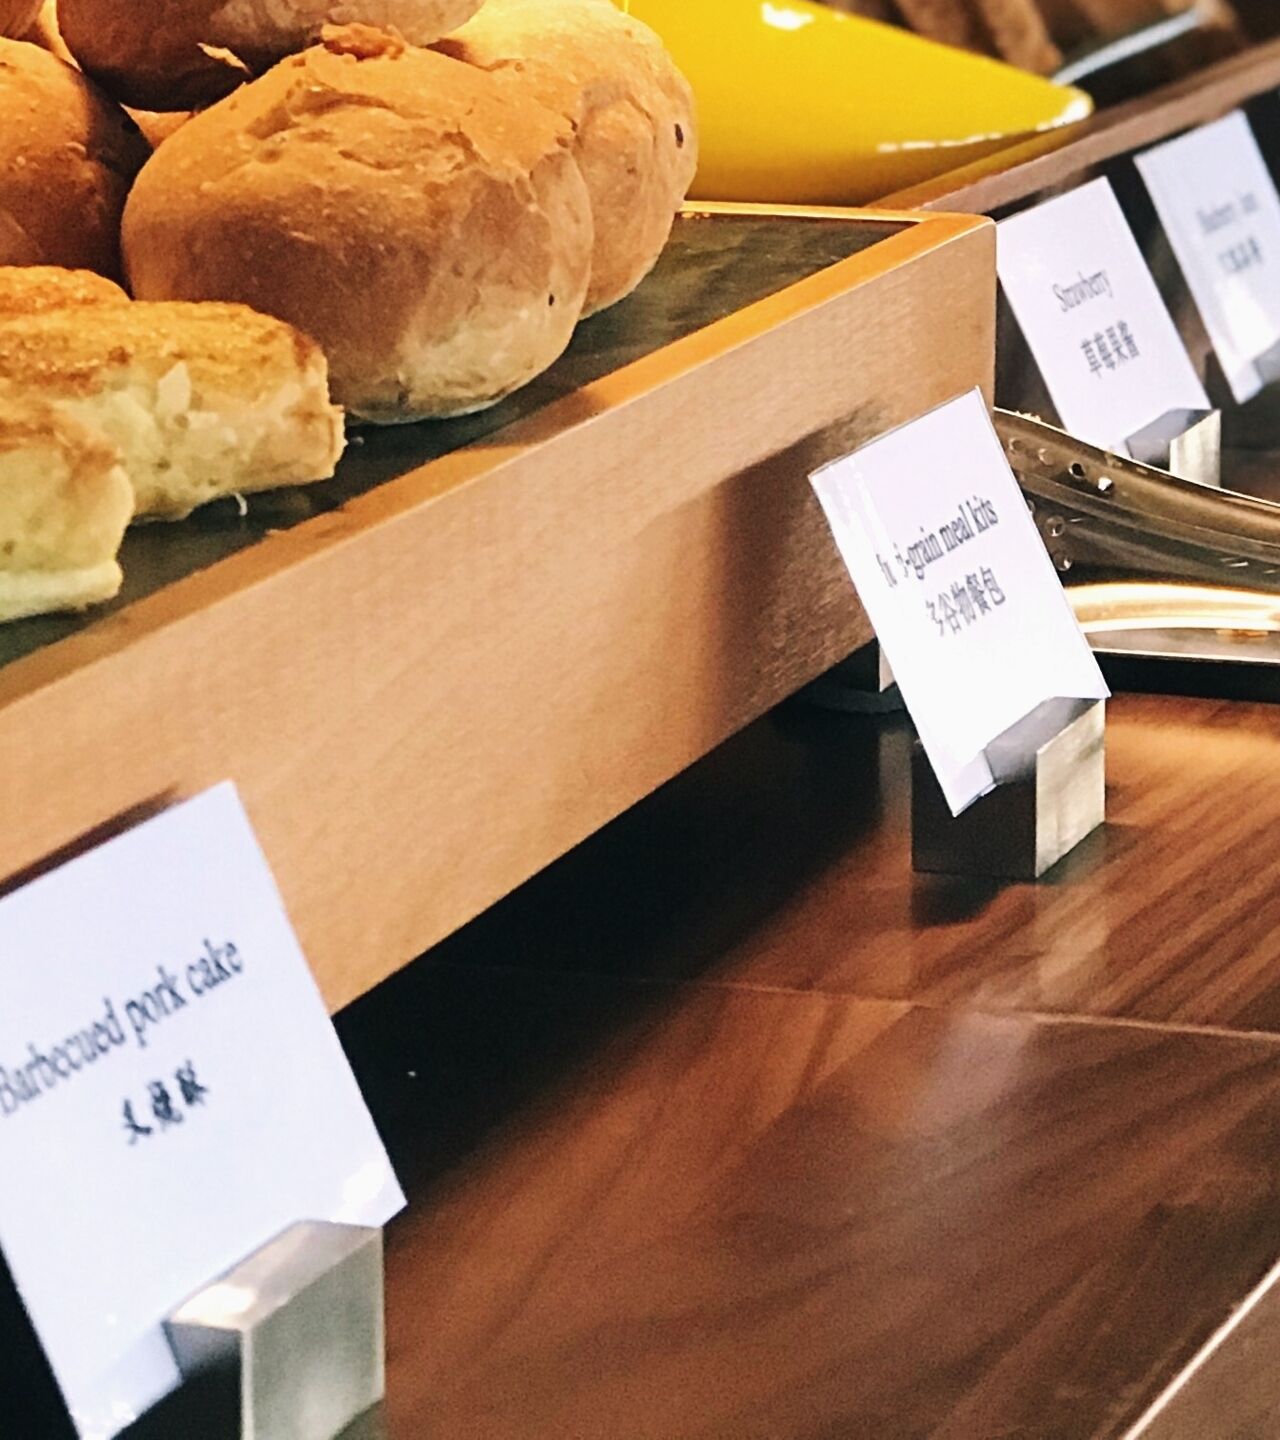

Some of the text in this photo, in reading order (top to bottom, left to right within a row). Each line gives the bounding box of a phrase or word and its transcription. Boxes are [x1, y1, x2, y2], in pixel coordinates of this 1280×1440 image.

[1052, 269, 1113, 312] Strawberry
[939, 504, 976, 552] meal
[966, 495, 999, 534] kits
[125, 965, 187, 1048] pork
[186, 938, 243, 996] cake
